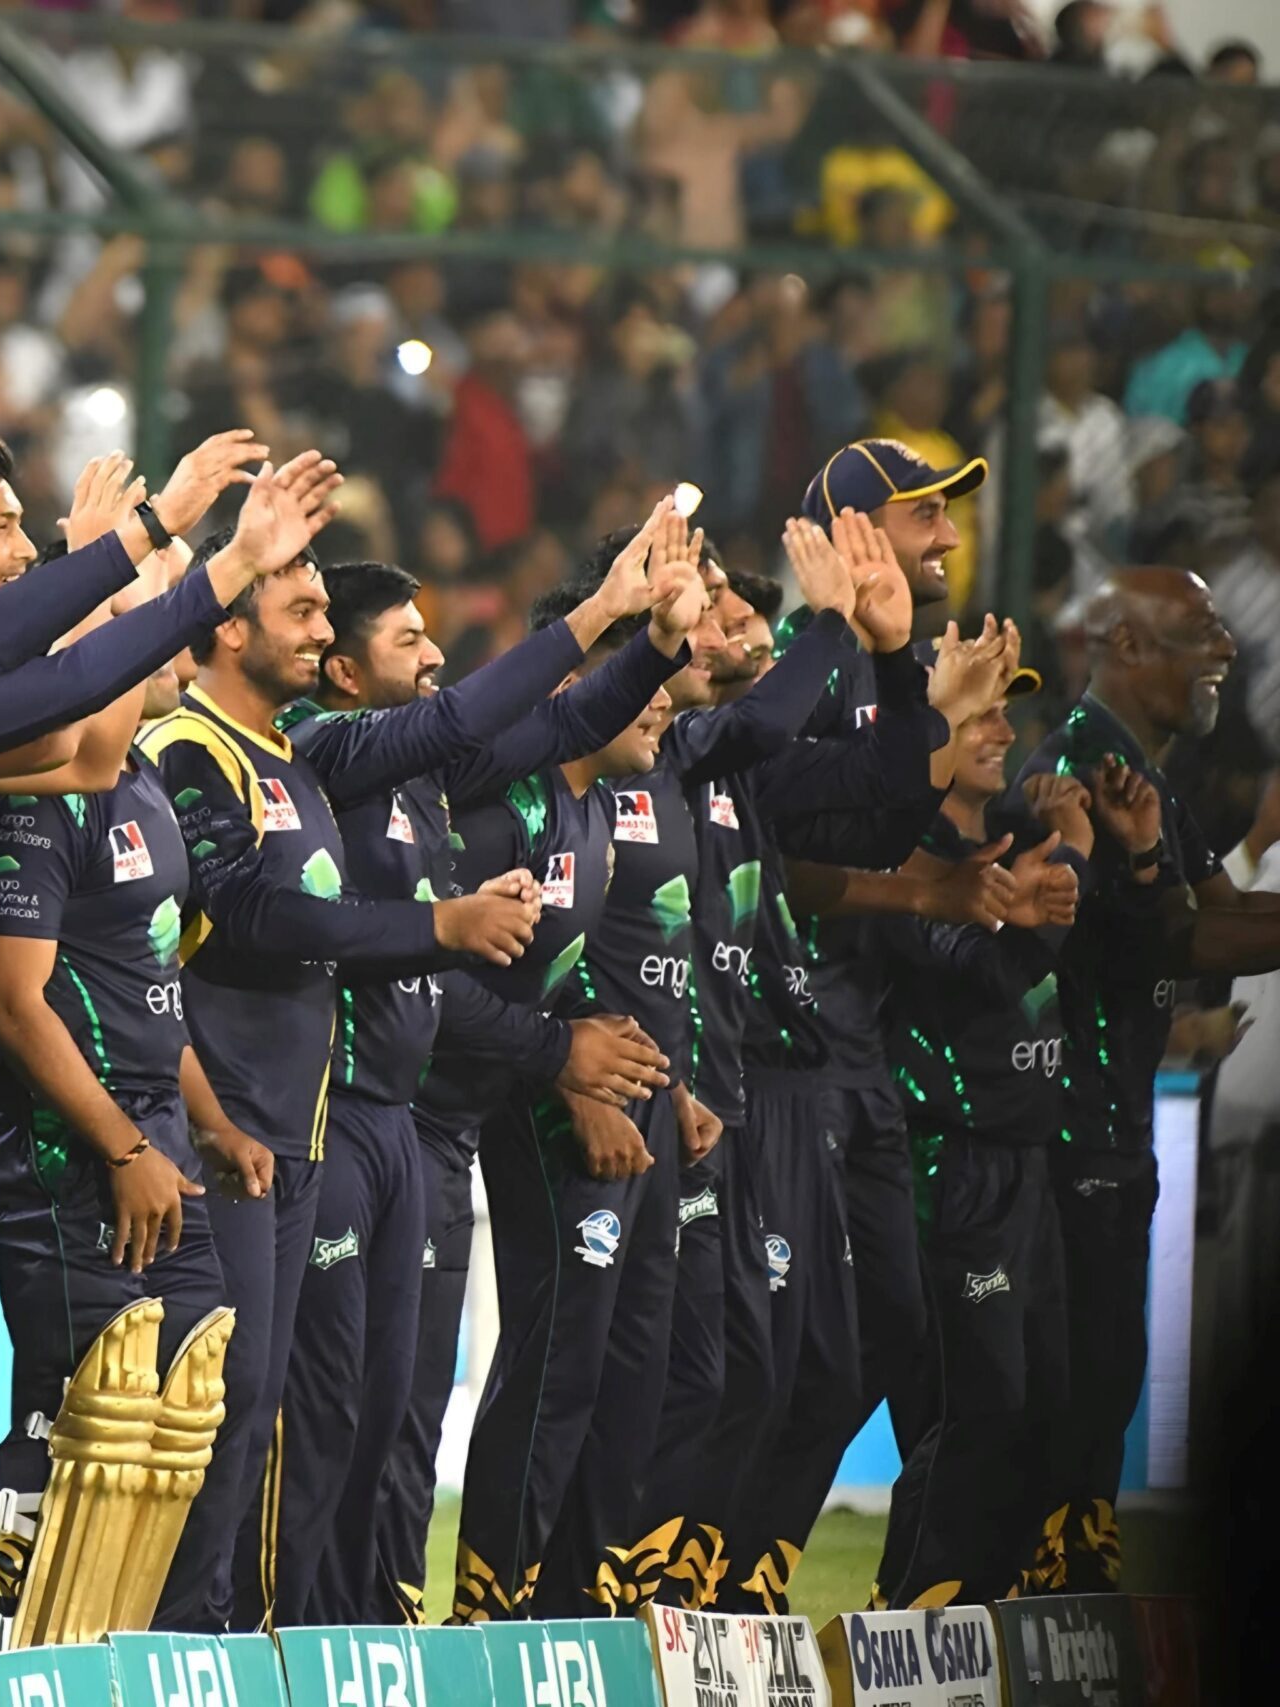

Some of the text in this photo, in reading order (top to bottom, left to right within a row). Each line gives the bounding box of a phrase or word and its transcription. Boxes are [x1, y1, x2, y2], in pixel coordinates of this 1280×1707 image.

[640, 955, 691, 998] eng
[1011, 1038, 1063, 1078] eng
[851, 1614, 922, 1691] OSAKA
